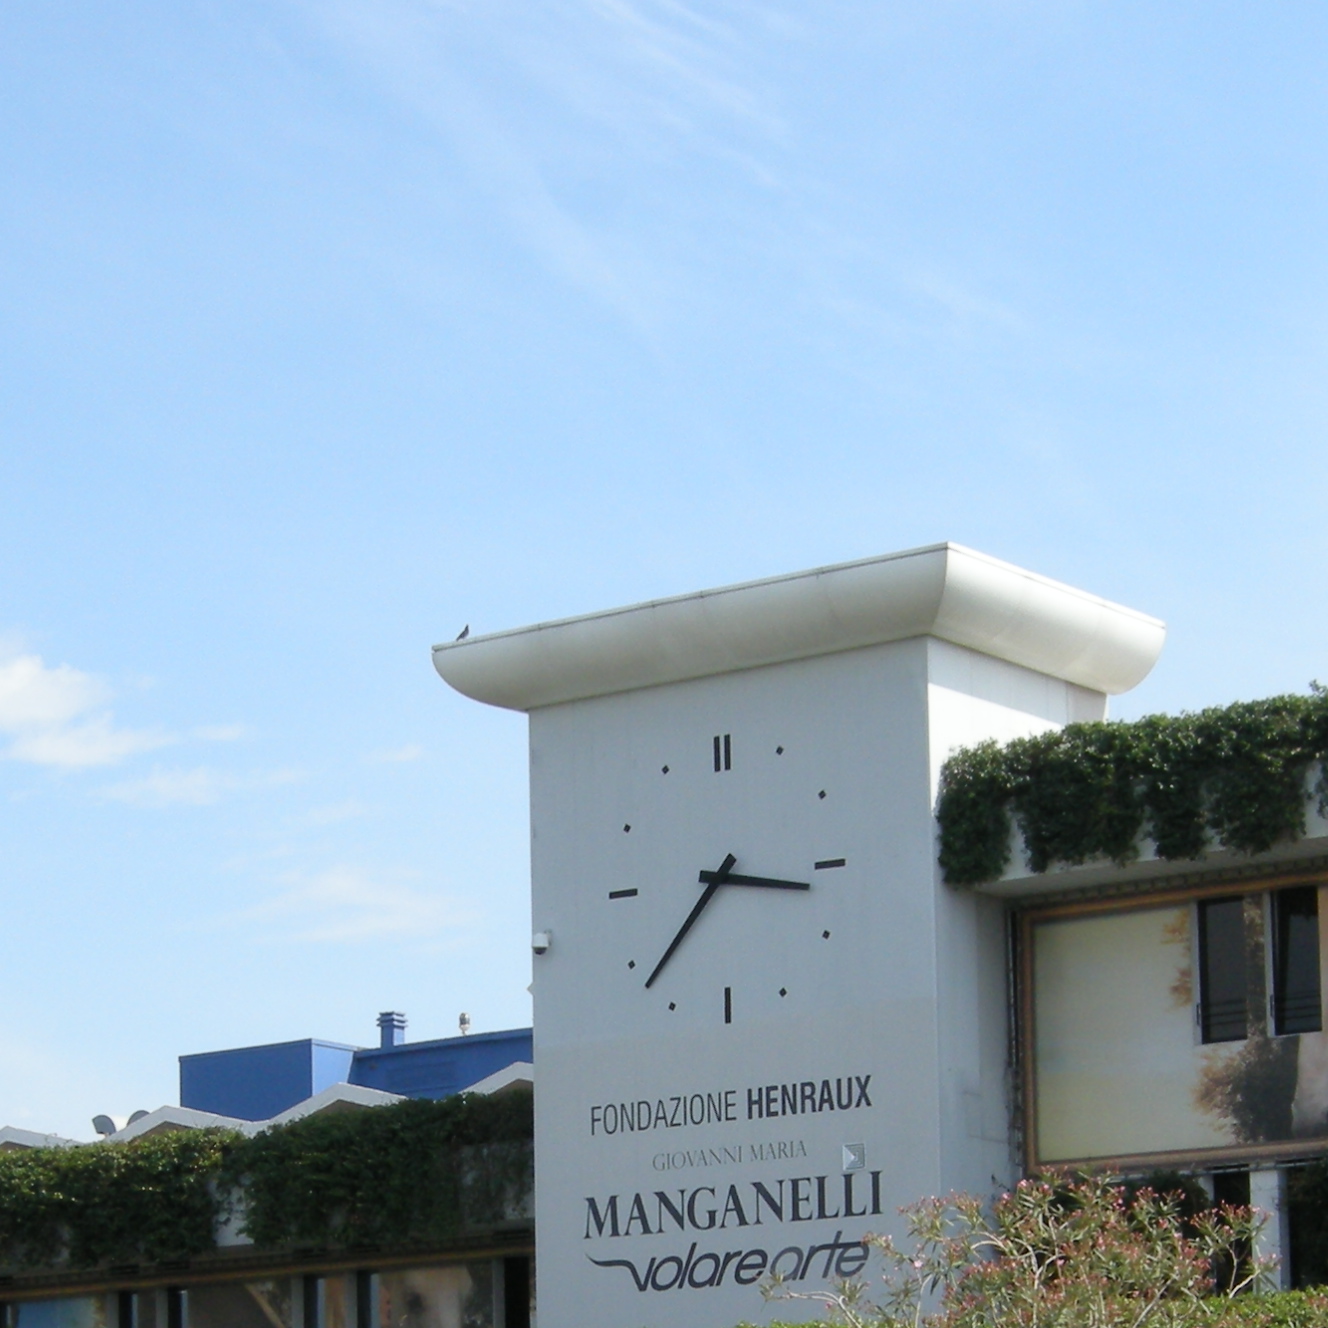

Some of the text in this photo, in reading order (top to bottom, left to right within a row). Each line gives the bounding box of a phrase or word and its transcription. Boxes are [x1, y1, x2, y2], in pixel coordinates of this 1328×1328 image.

[590, 1074, 872, 1136] FONDAZIONE HENRAUX
[652, 1140, 808, 1172] GIOVANNI MARIA
[583, 1170, 884, 1239] MANGANELLI
